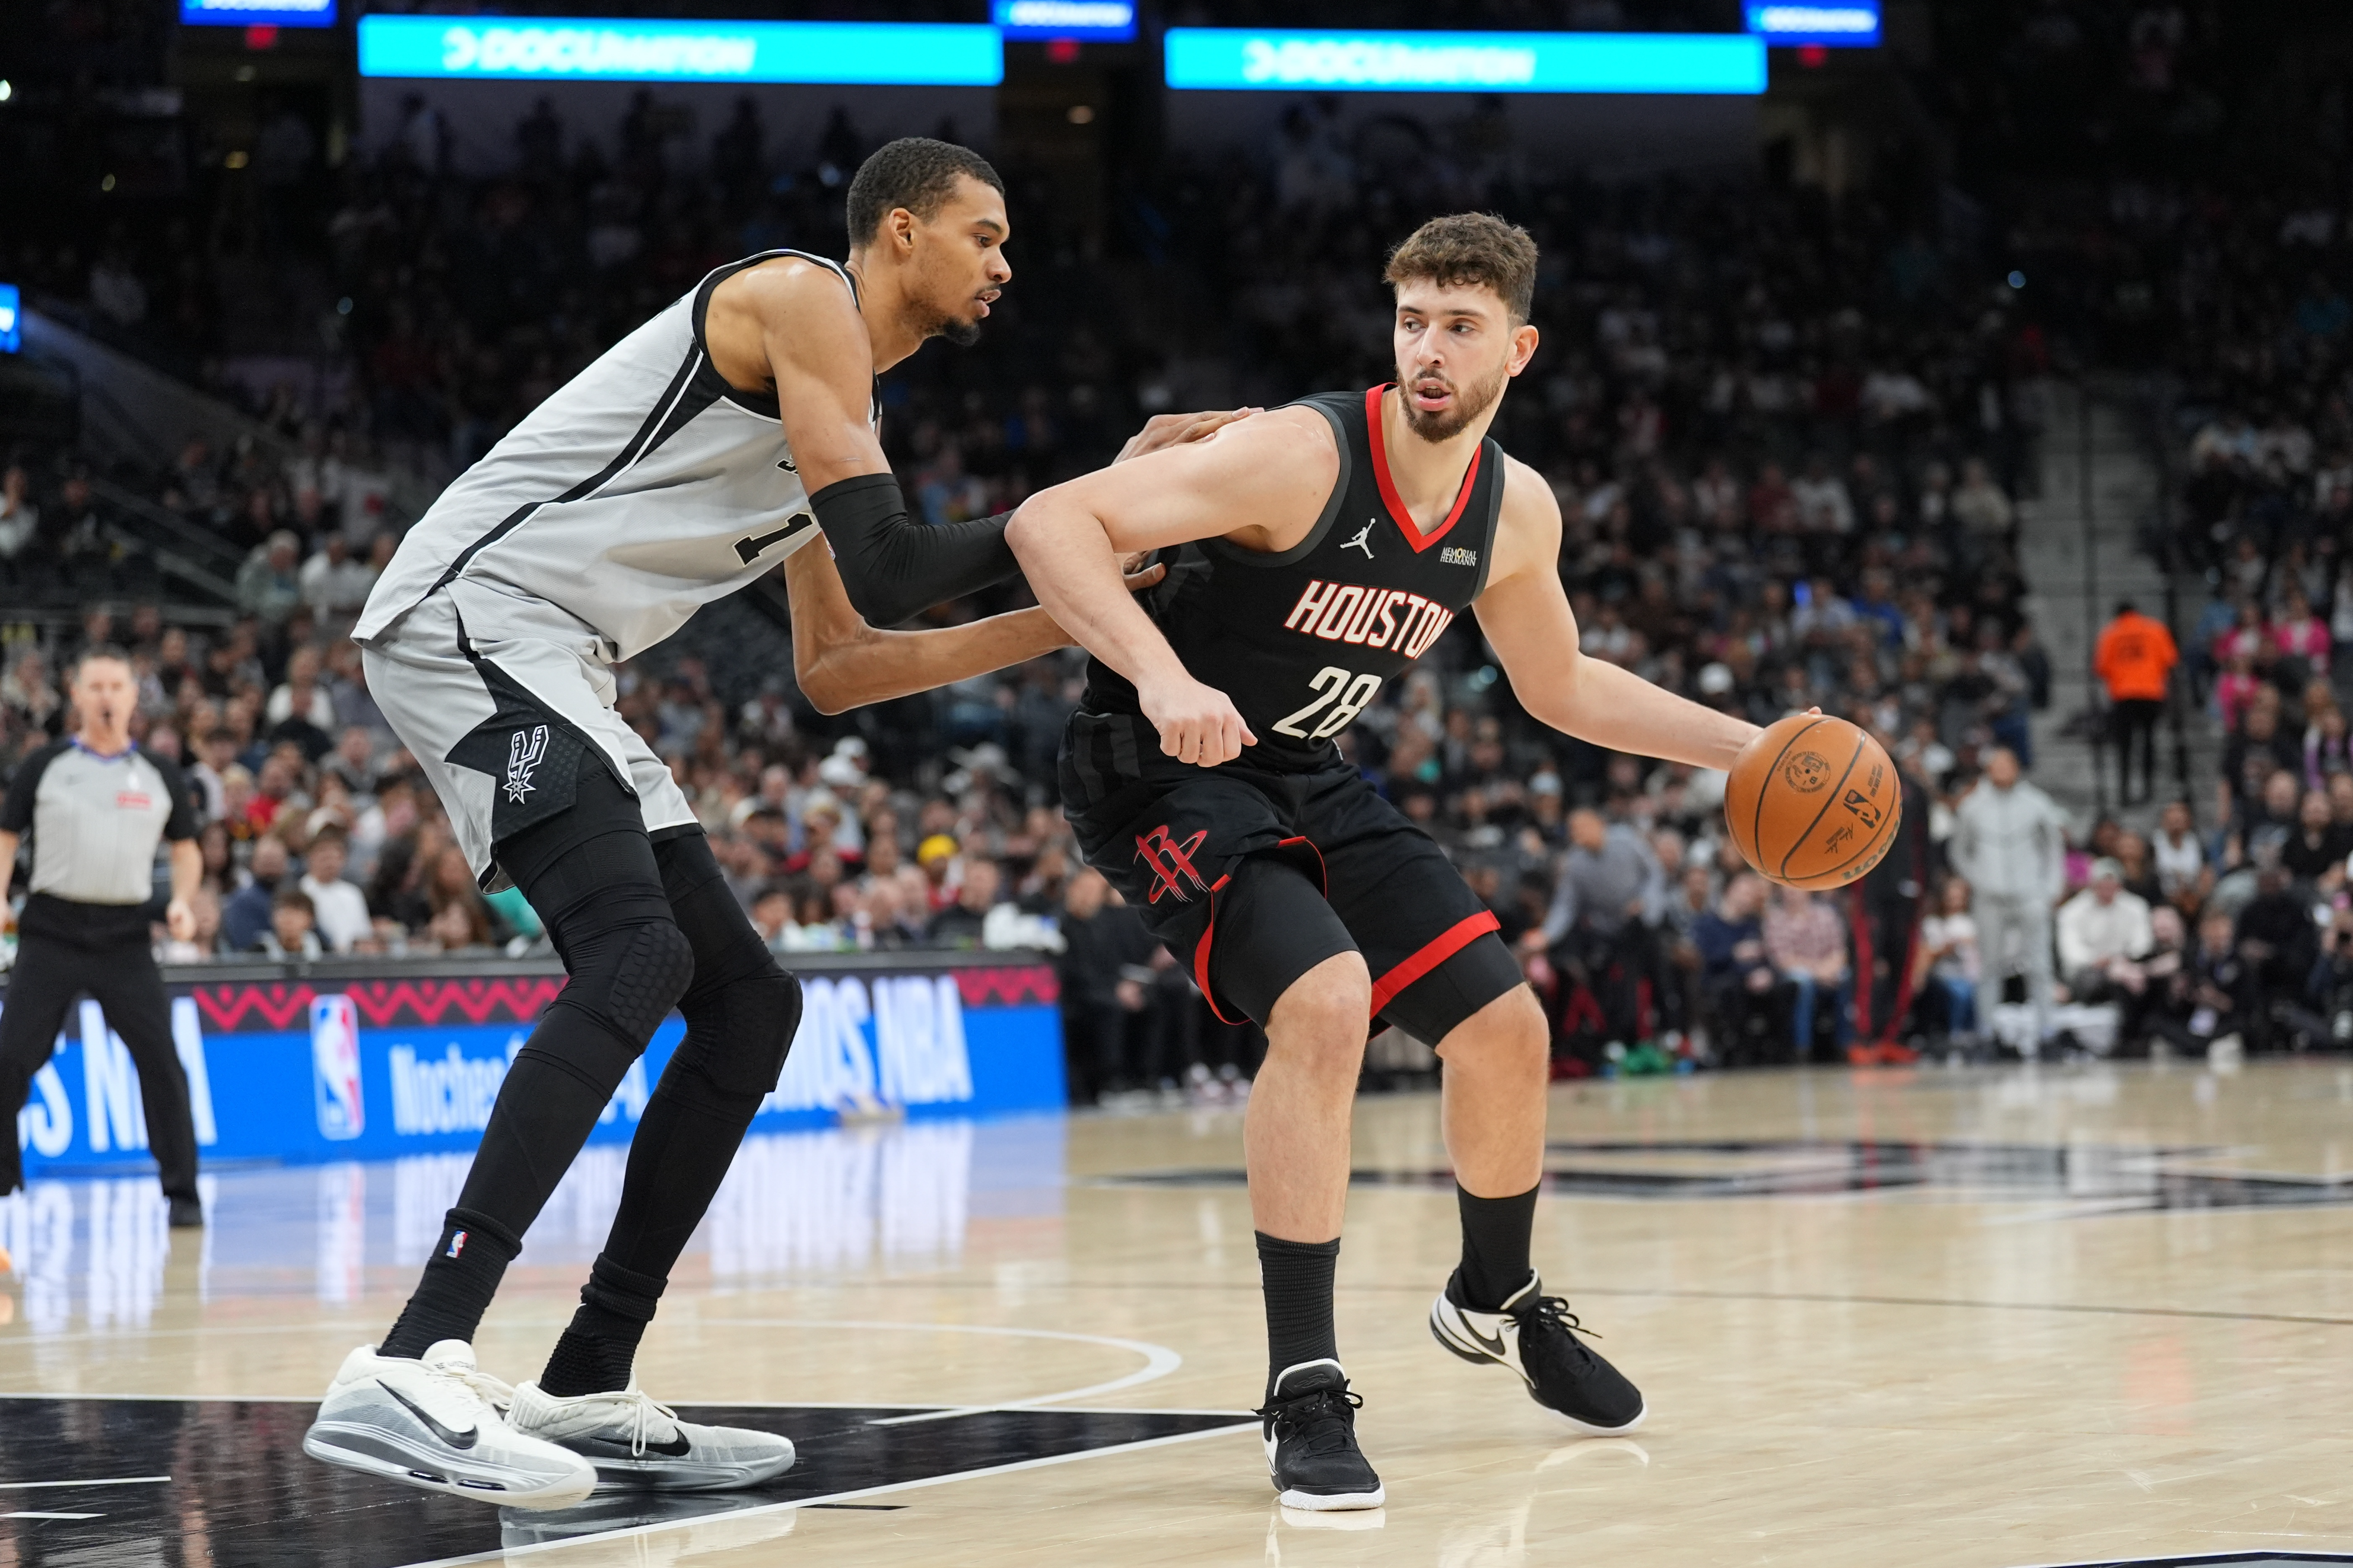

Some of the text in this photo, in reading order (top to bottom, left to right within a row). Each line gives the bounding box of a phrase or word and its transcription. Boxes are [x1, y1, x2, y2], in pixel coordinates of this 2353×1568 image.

[732, 511, 815, 568] 1
[1440, 554, 1477, 567] HERMANN
[1441, 547, 1476, 559] MEMORIAL
[1283, 579, 1455, 660] HOUSTON
[1271, 666, 1382, 740] 28
[871, 974, 974, 1103] NBA
